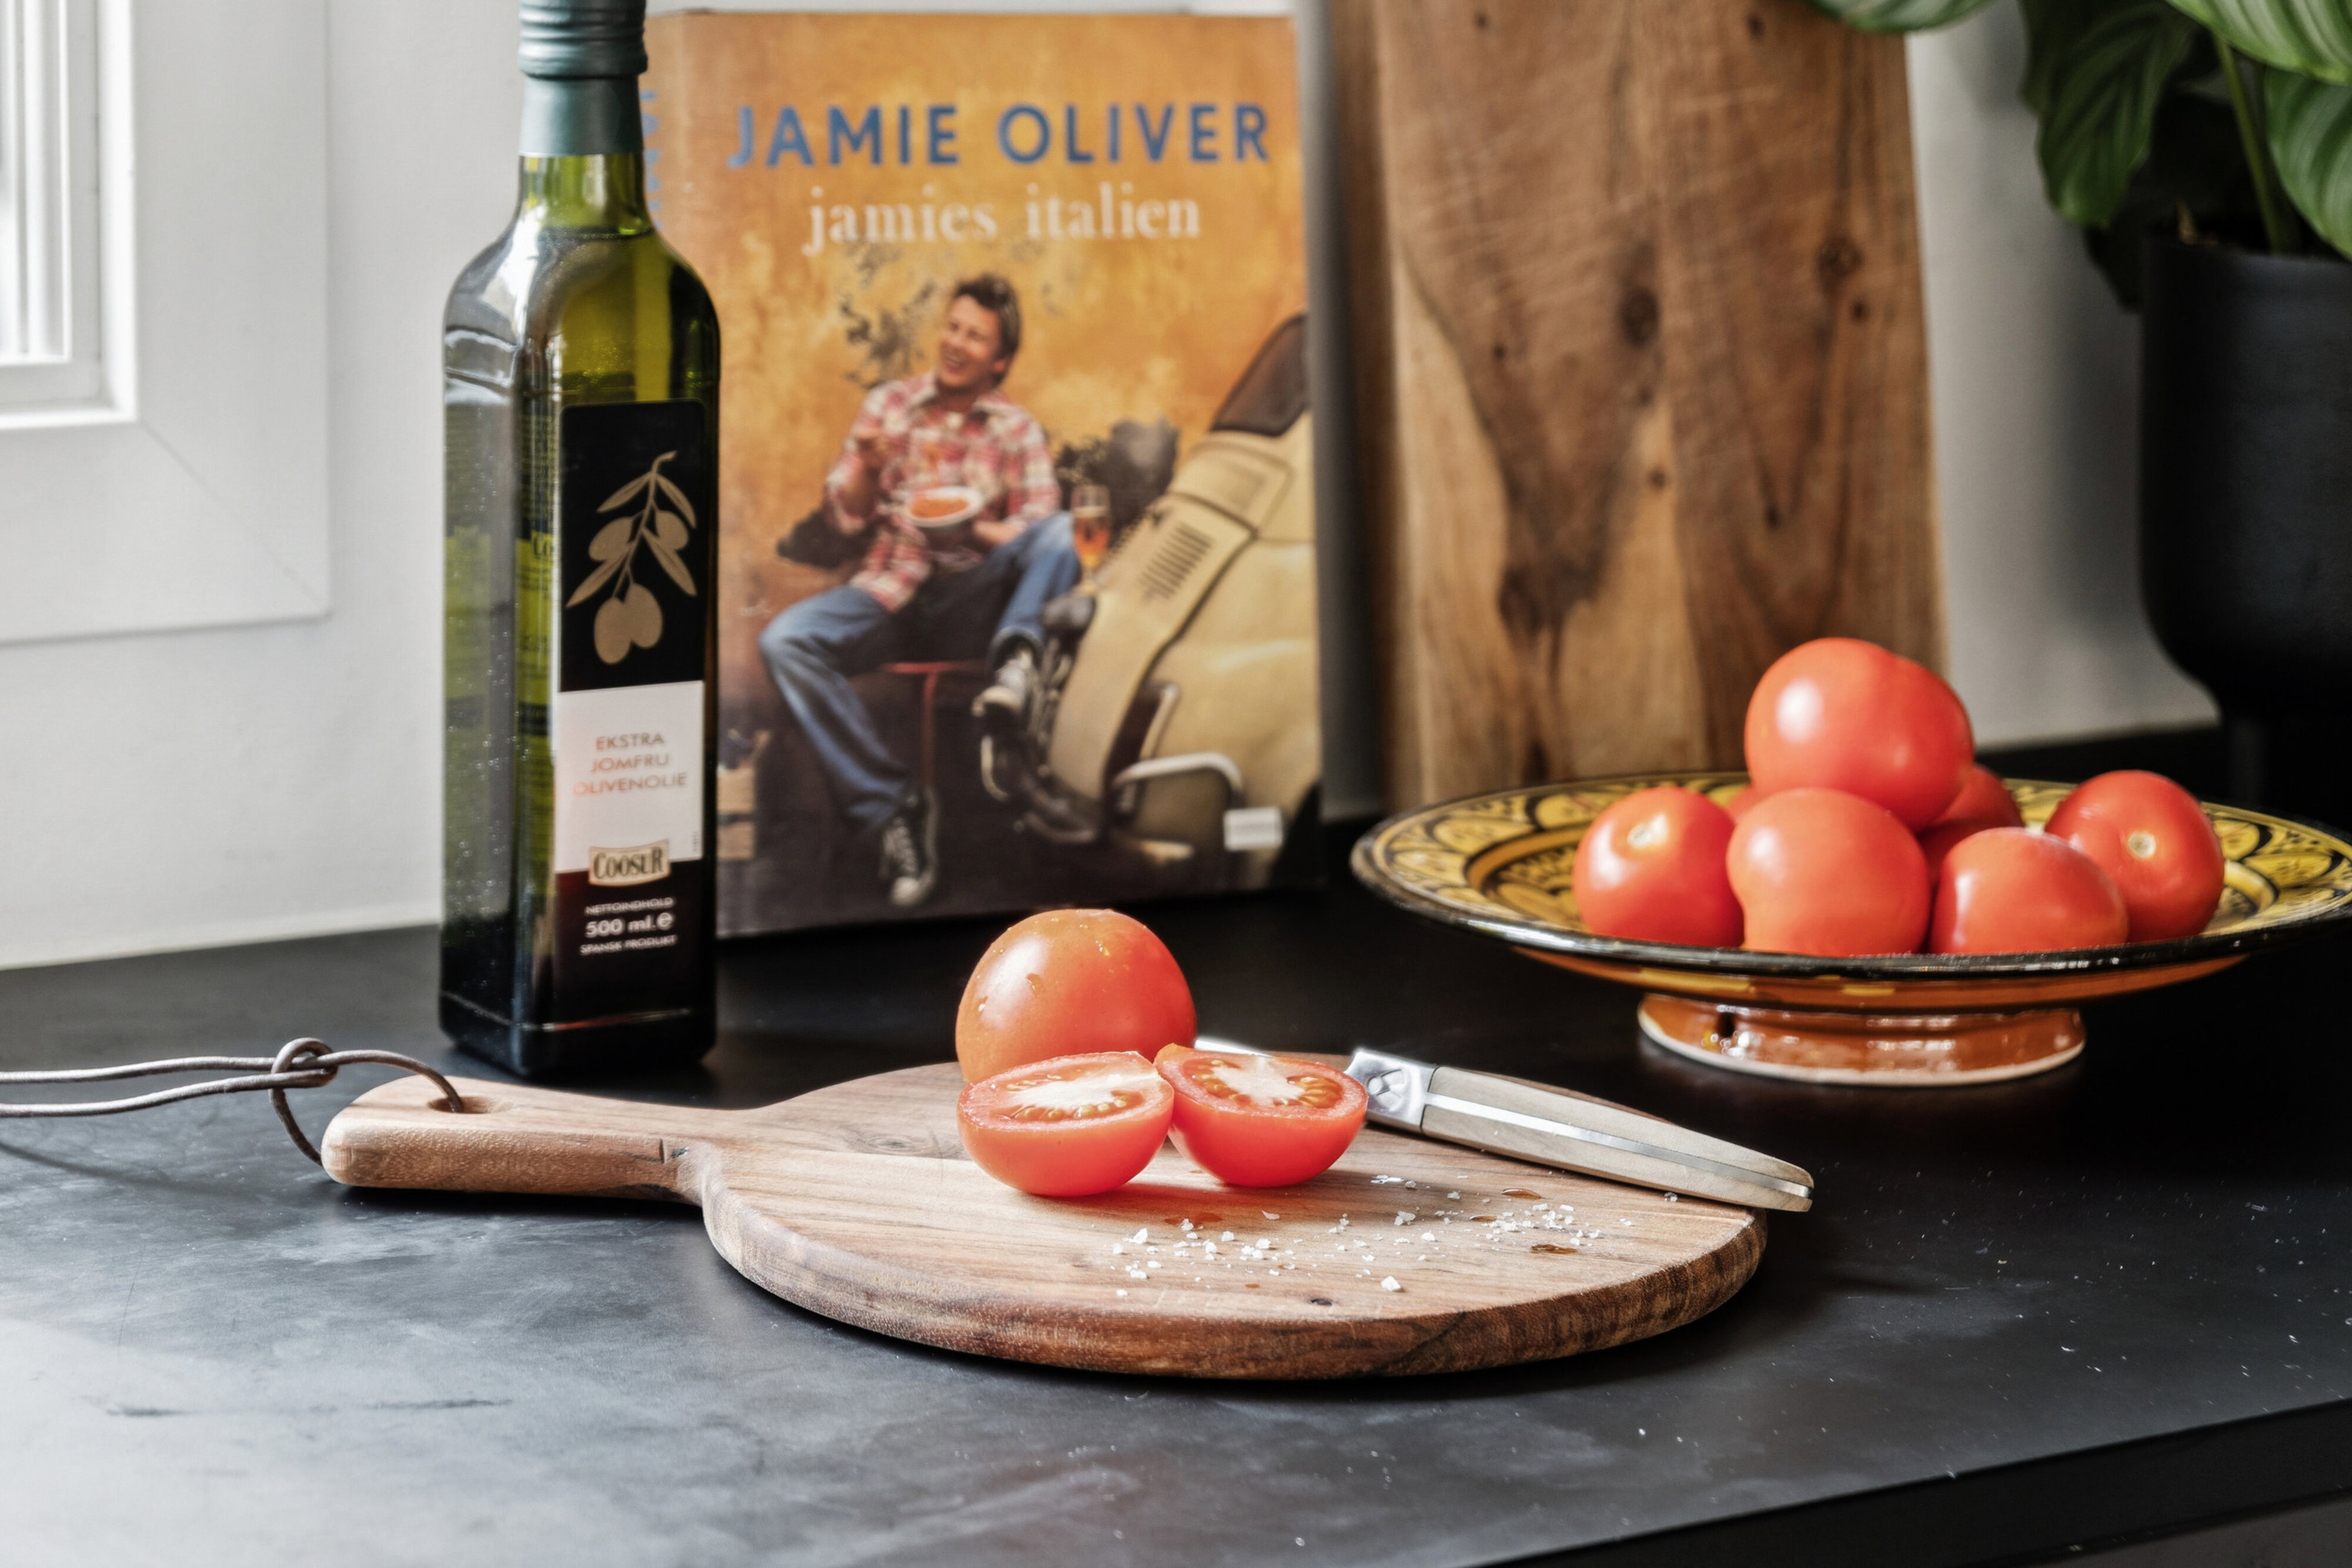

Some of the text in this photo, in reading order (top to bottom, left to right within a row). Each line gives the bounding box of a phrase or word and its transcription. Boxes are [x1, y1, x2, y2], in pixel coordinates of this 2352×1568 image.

[727, 105, 960, 168] JAMIE
[997, 103, 1271, 165] OLIVER
[801, 182, 1202, 256] jamies italien
[595, 733, 665, 750] EKSTRA
[592, 753, 669, 773] JOMFRU
[573, 772, 687, 796] OLIVENOLIE
[585, 897, 675, 915] NETTOINDHOLD
[586, 918, 623, 938] 500
[580, 935, 677, 955] SPANSK PRODUKT
